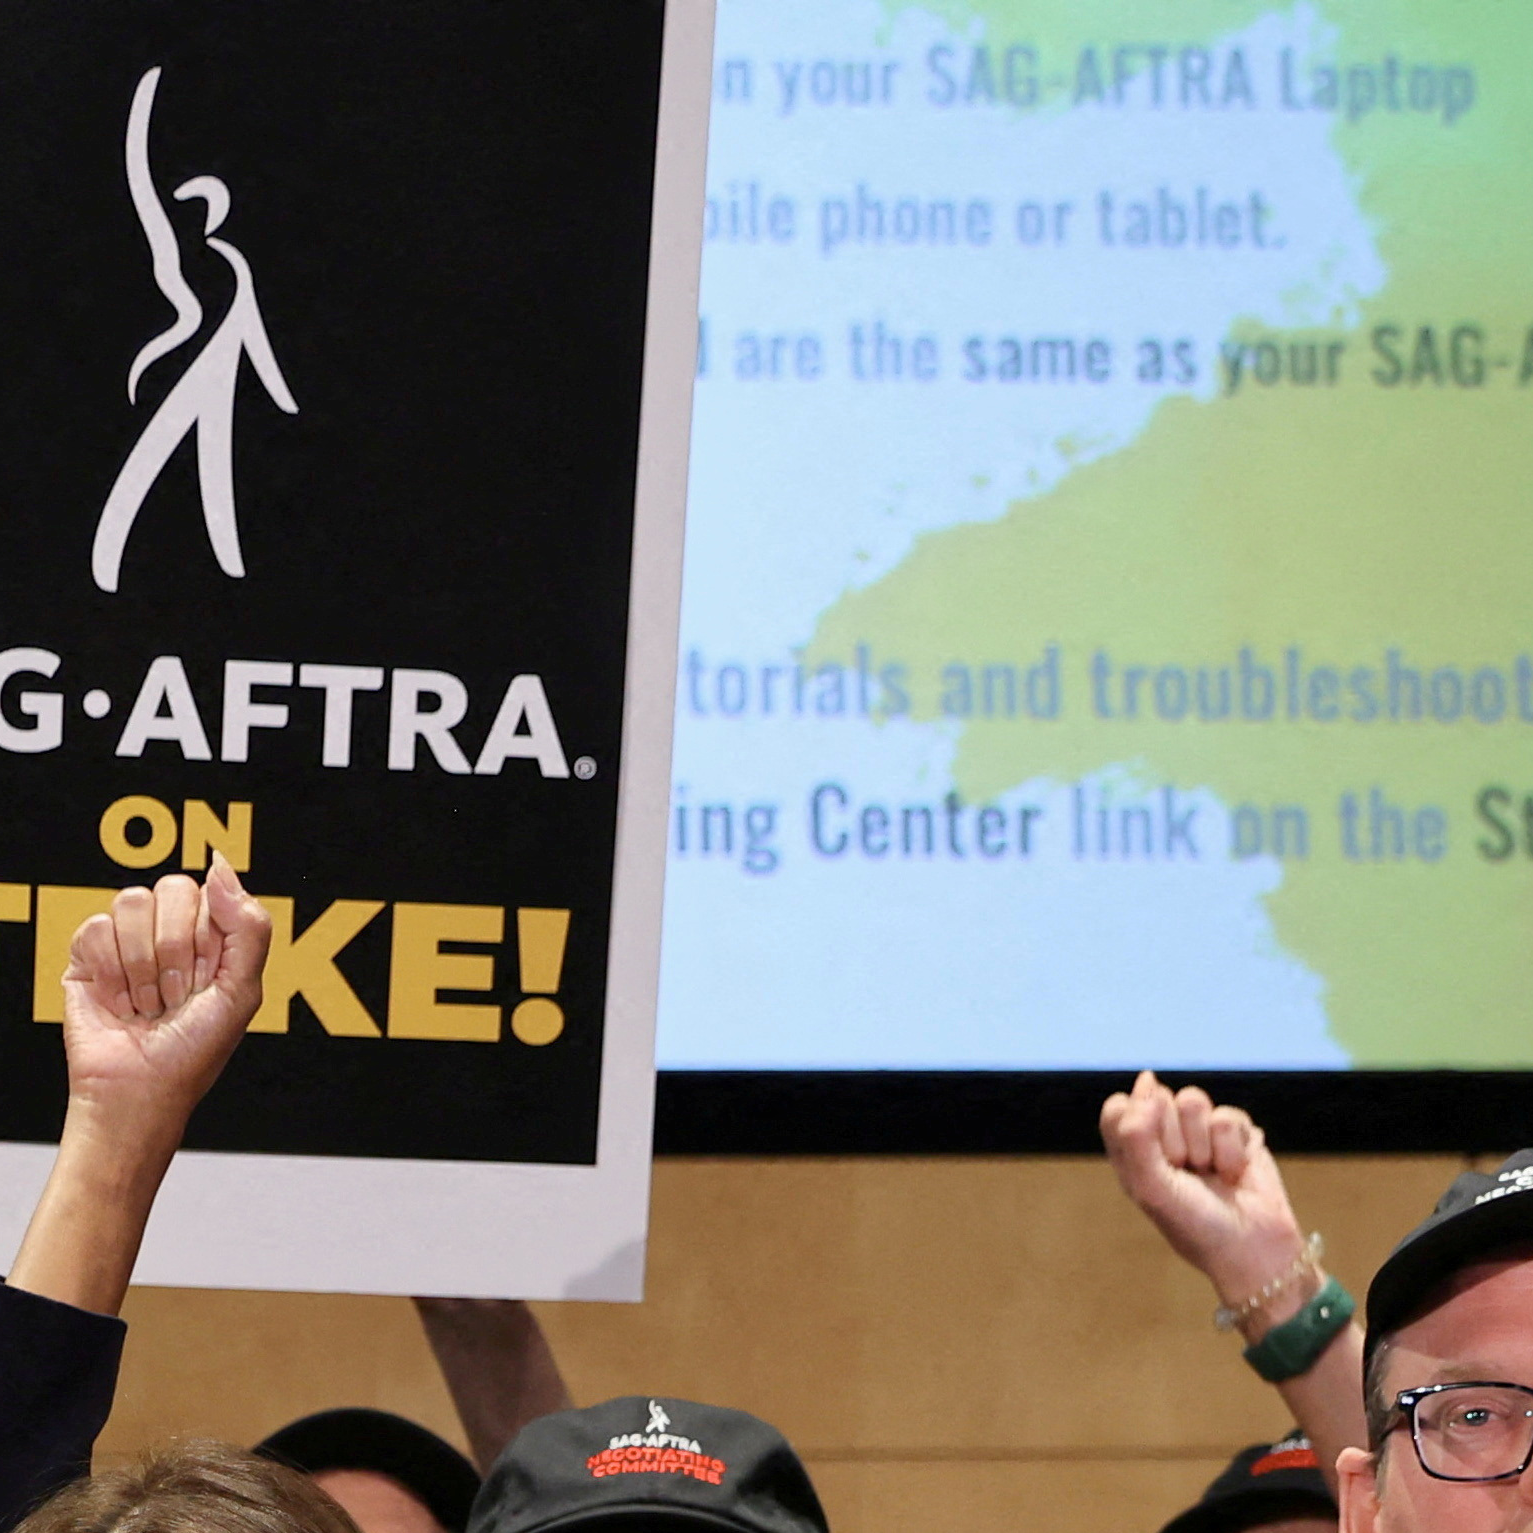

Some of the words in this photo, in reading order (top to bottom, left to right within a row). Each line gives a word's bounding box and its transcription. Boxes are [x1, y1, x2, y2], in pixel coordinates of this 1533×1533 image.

[777, 56, 897, 118] your
[926, 44, 1255, 111] SAG-AFTRA
[1279, 46, 1477, 123] Laptop
[820, 181, 992, 256] phone
[1015, 196, 1071, 243] or
[1096, 186, 1288, 252] tablet.
[734, 330, 822, 383] are
[846, 318, 939, 384] the
[962, 330, 1111, 386] same
[1136, 332, 1197, 386] as
[1220, 334, 1346, 397] your
[686, 644, 911, 719] torials
[940, 645, 1062, 722] and
[101, 795, 254, 874] ON
[807, 782, 1044, 864] Center
[1071, 787, 1201, 860] link
[1229, 800, 1310, 862] on
[1339, 790, 1447, 863] the
[585, 1446, 727, 1474] NEGOTIATING
[591, 1460, 723, 1486] COMMITTEE
